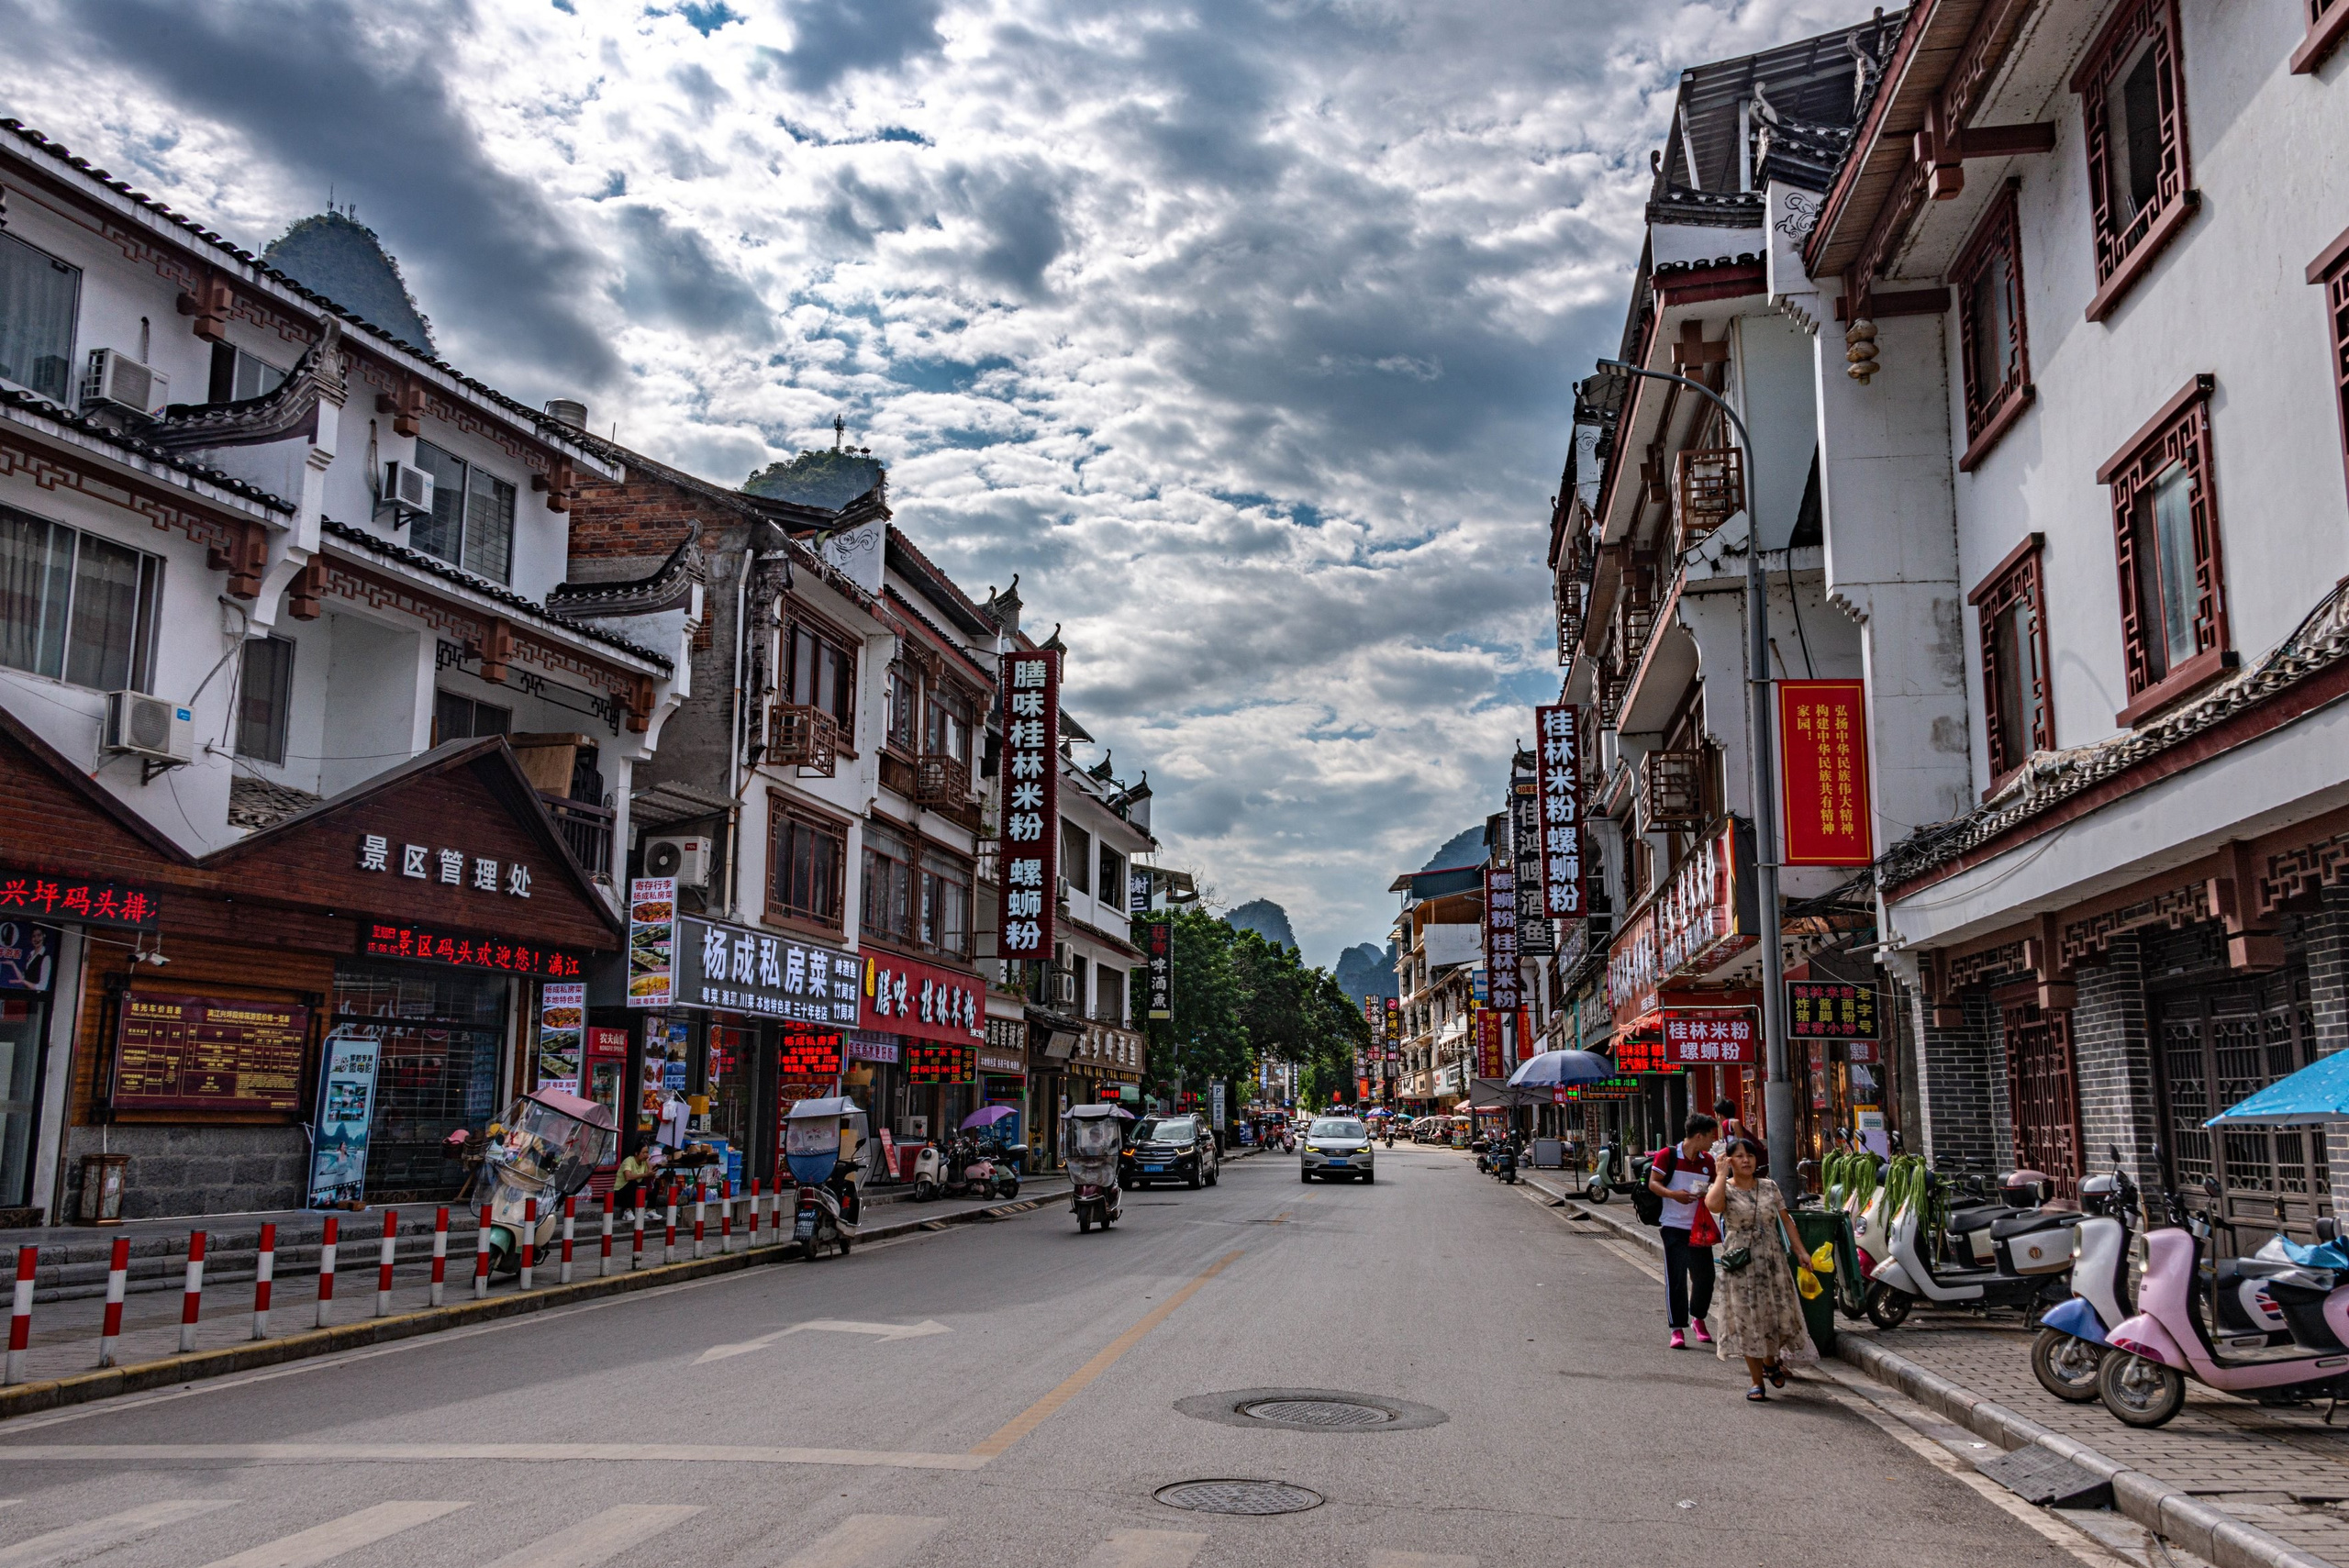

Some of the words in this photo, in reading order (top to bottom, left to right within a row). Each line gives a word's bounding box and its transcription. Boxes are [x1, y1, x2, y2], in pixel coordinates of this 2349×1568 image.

[1008, 660, 1047, 841] 膳味桂林米粉
[1542, 709, 1576, 823] 桂林米粉
[1816, 705, 1834, 835] 构建中华民族共有精神
[1835, 705, 1854, 841] 弘扬中华民族伟大精神，
[361, 834, 532, 898] 景区管理处
[1546, 827, 1580, 912] 螺蛳粉
[635, 880, 673, 890] 寄存行李
[0, 879, 158, 924] 兴坪码头排
[633, 891, 674, 900] 杨成私房菜
[1006, 858, 1043, 950] 螺蛳粉
[1490, 873, 1515, 929] 螺蛳粉
[703, 926, 829, 998] 杨成私房菜
[835, 959, 857, 979] 啤酒鱼
[1492, 933, 1517, 1008] 桂林米粉
[545, 984, 583, 994] 杨成私房菜
[834, 981, 856, 1001] 竹筒饭
[1794, 985, 1854, 999] 桂林米粉
[131, 1002, 182, 1015] 观光车价目表
[544, 995, 582, 1005] 本地特色菜
[629, 997, 641, 1006] 川菜
[702, 987, 718, 1004] 粤菜
[722, 990, 737, 1006] 湘菜
[740, 993, 754, 1008] 川菜
[756, 995, 791, 1015] 本地特色菜
[793, 1002, 828, 1021] 三十年老店
[1796, 998, 1854, 1011] 炸酱面
[833, 1003, 855, 1021] 竹筒鸡
[1796, 1010, 1855, 1023] 猪脚粉
[1856, 987, 1873, 1033] 老字号
[1669, 1021, 1750, 1040] 桂林米粉
[1795, 1022, 1856, 1035] 家常小炒
[599, 1032, 625, 1045] 农夫山泉
[784, 1036, 839, 1046] 杨成私房菜
[1680, 1042, 1741, 1060] 螺蛳粉
[910, 1065, 961, 1073] 黄焖鸡米饭
[963, 1051, 973, 1081] 老字号
